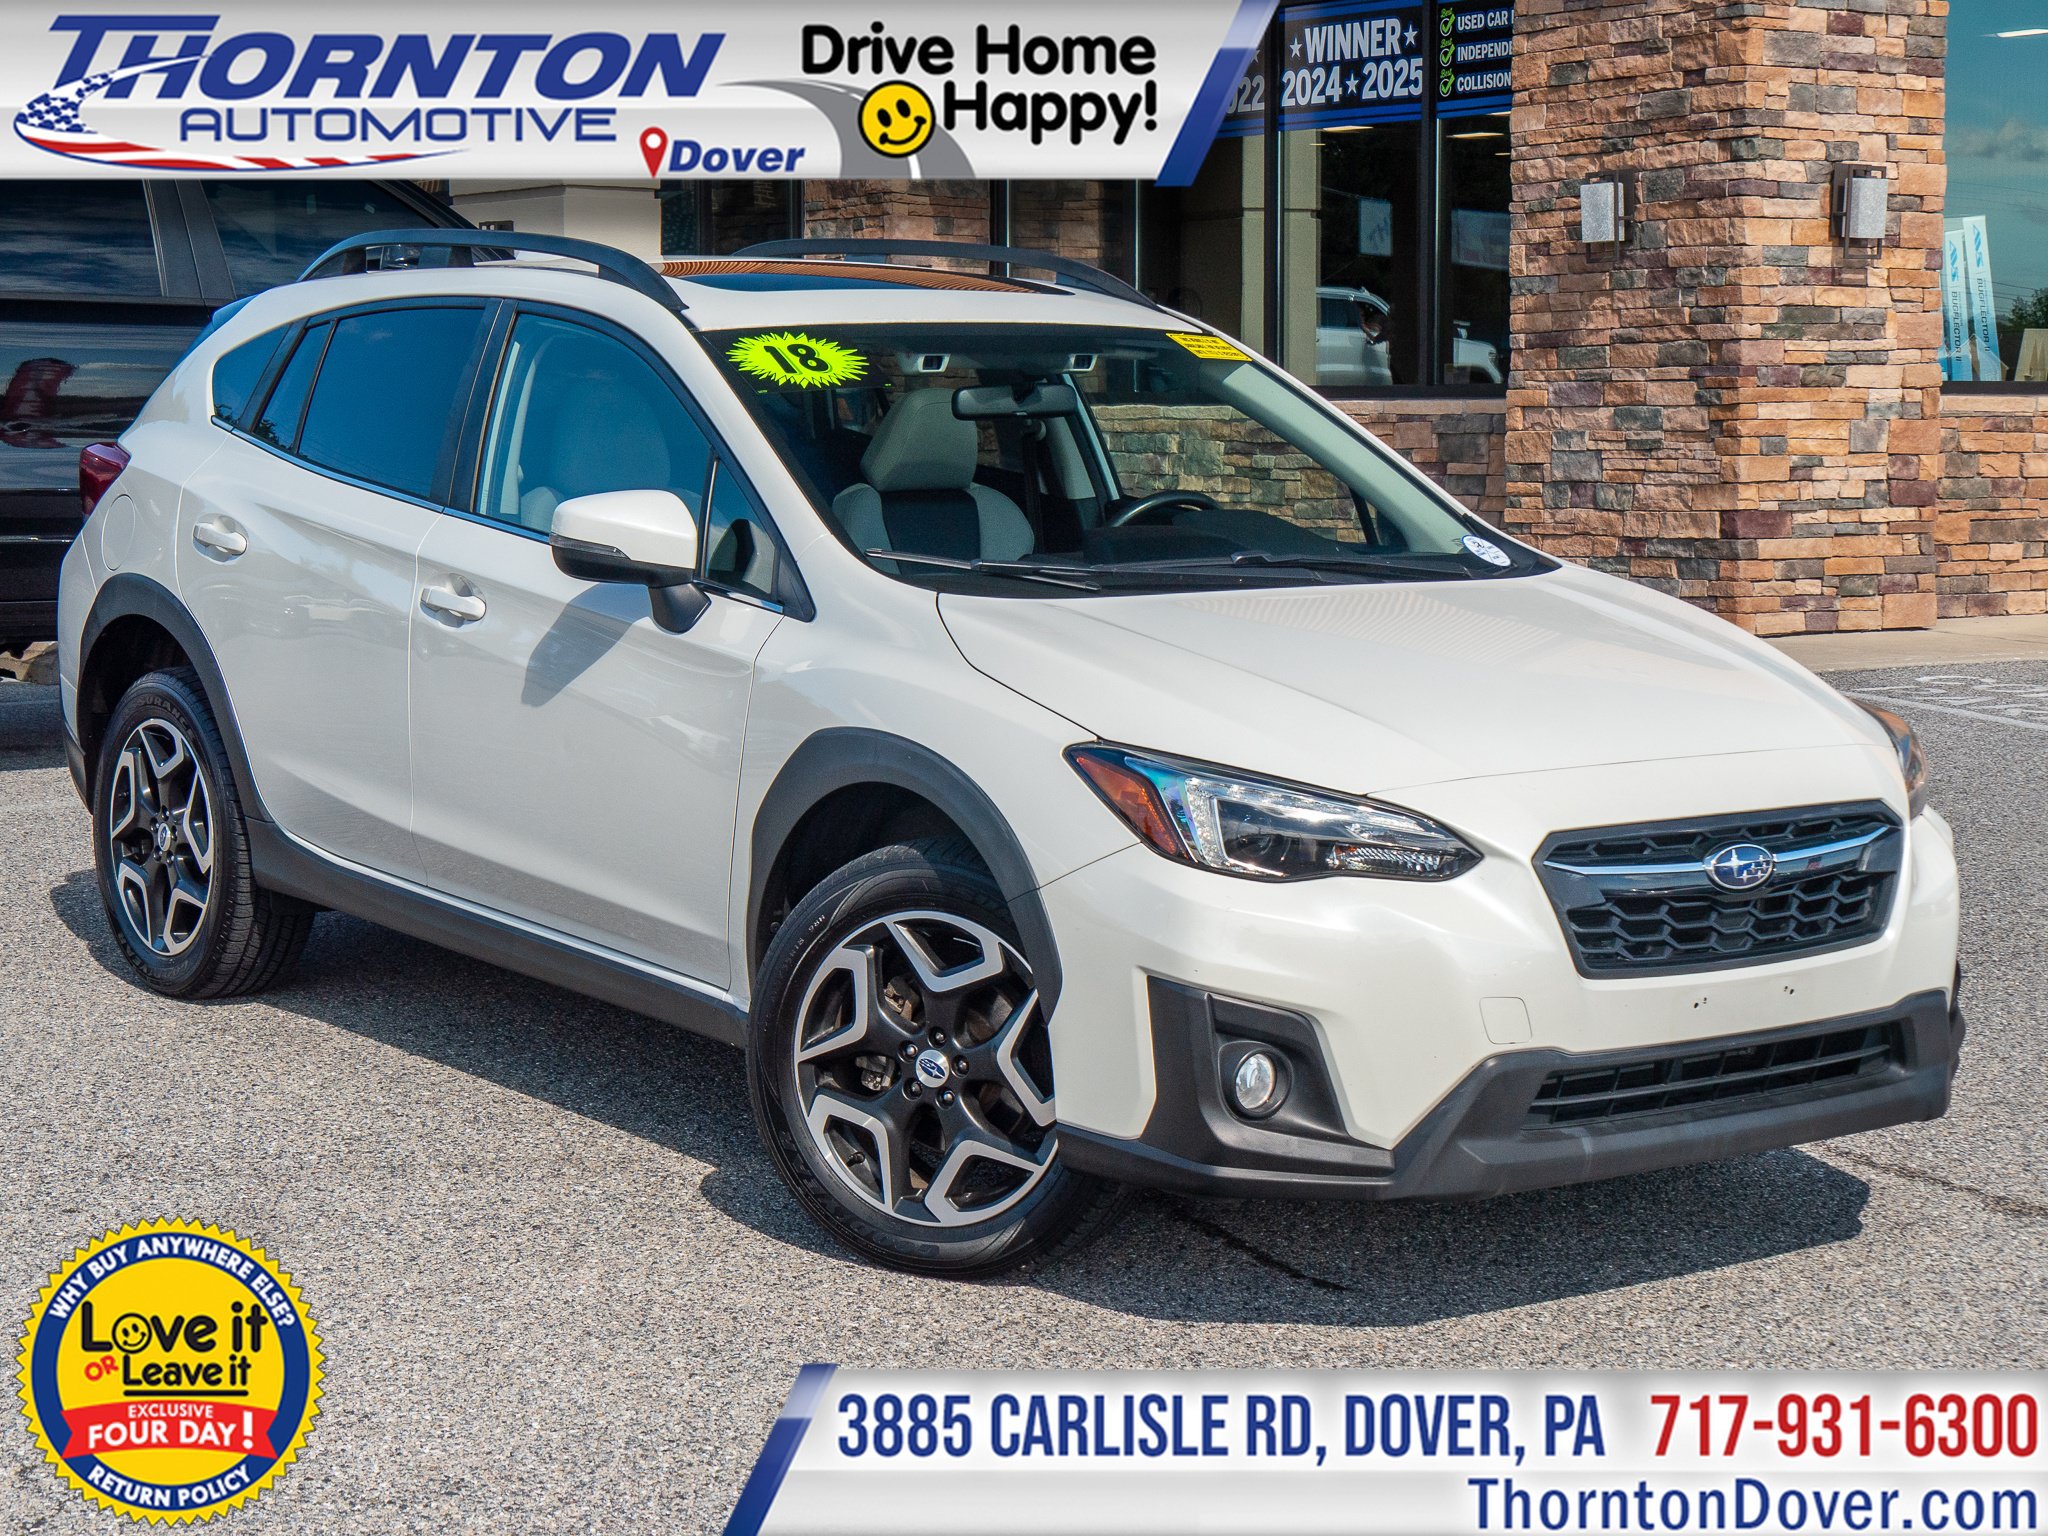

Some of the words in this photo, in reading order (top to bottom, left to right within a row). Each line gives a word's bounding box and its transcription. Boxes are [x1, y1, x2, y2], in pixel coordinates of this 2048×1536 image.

[1304, 18, 1400, 63] WINNER
[1457, 13, 1485, 31] USED
[1487, 10, 1508, 27] CAR
[1281, 66, 1342, 107] 2024
[1361, 58, 1423, 100] 2025
[1457, 71, 1512, 91] COLLISION
[1951, 291, 1962, 356] BUGFLECTOR
[1976, 277, 1992, 345] BUGFLECTOR
[763, 343, 833, 374] 18
